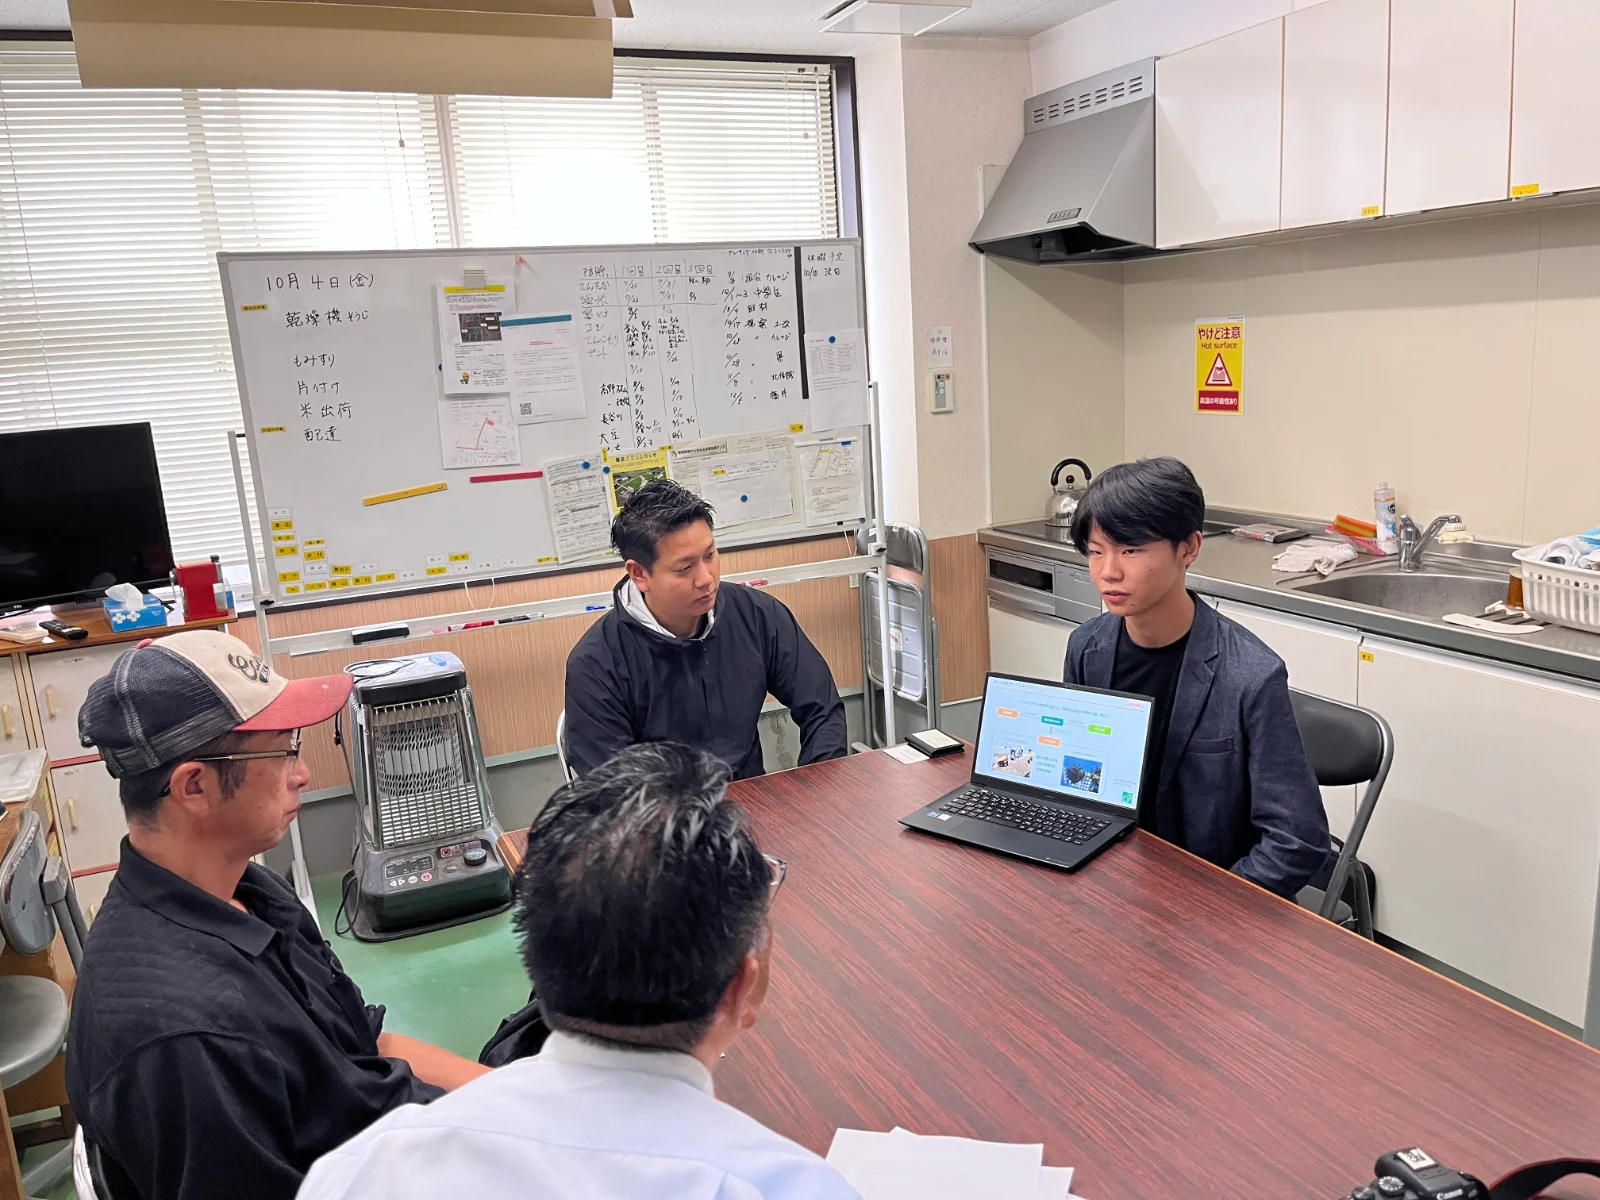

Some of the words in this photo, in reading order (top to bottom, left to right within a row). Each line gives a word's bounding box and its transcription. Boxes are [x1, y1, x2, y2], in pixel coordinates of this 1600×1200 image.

[1197, 326, 1241, 340] やけど注意
[1214, 341, 1237, 349] surface
[304, 425, 342, 442] 配達
